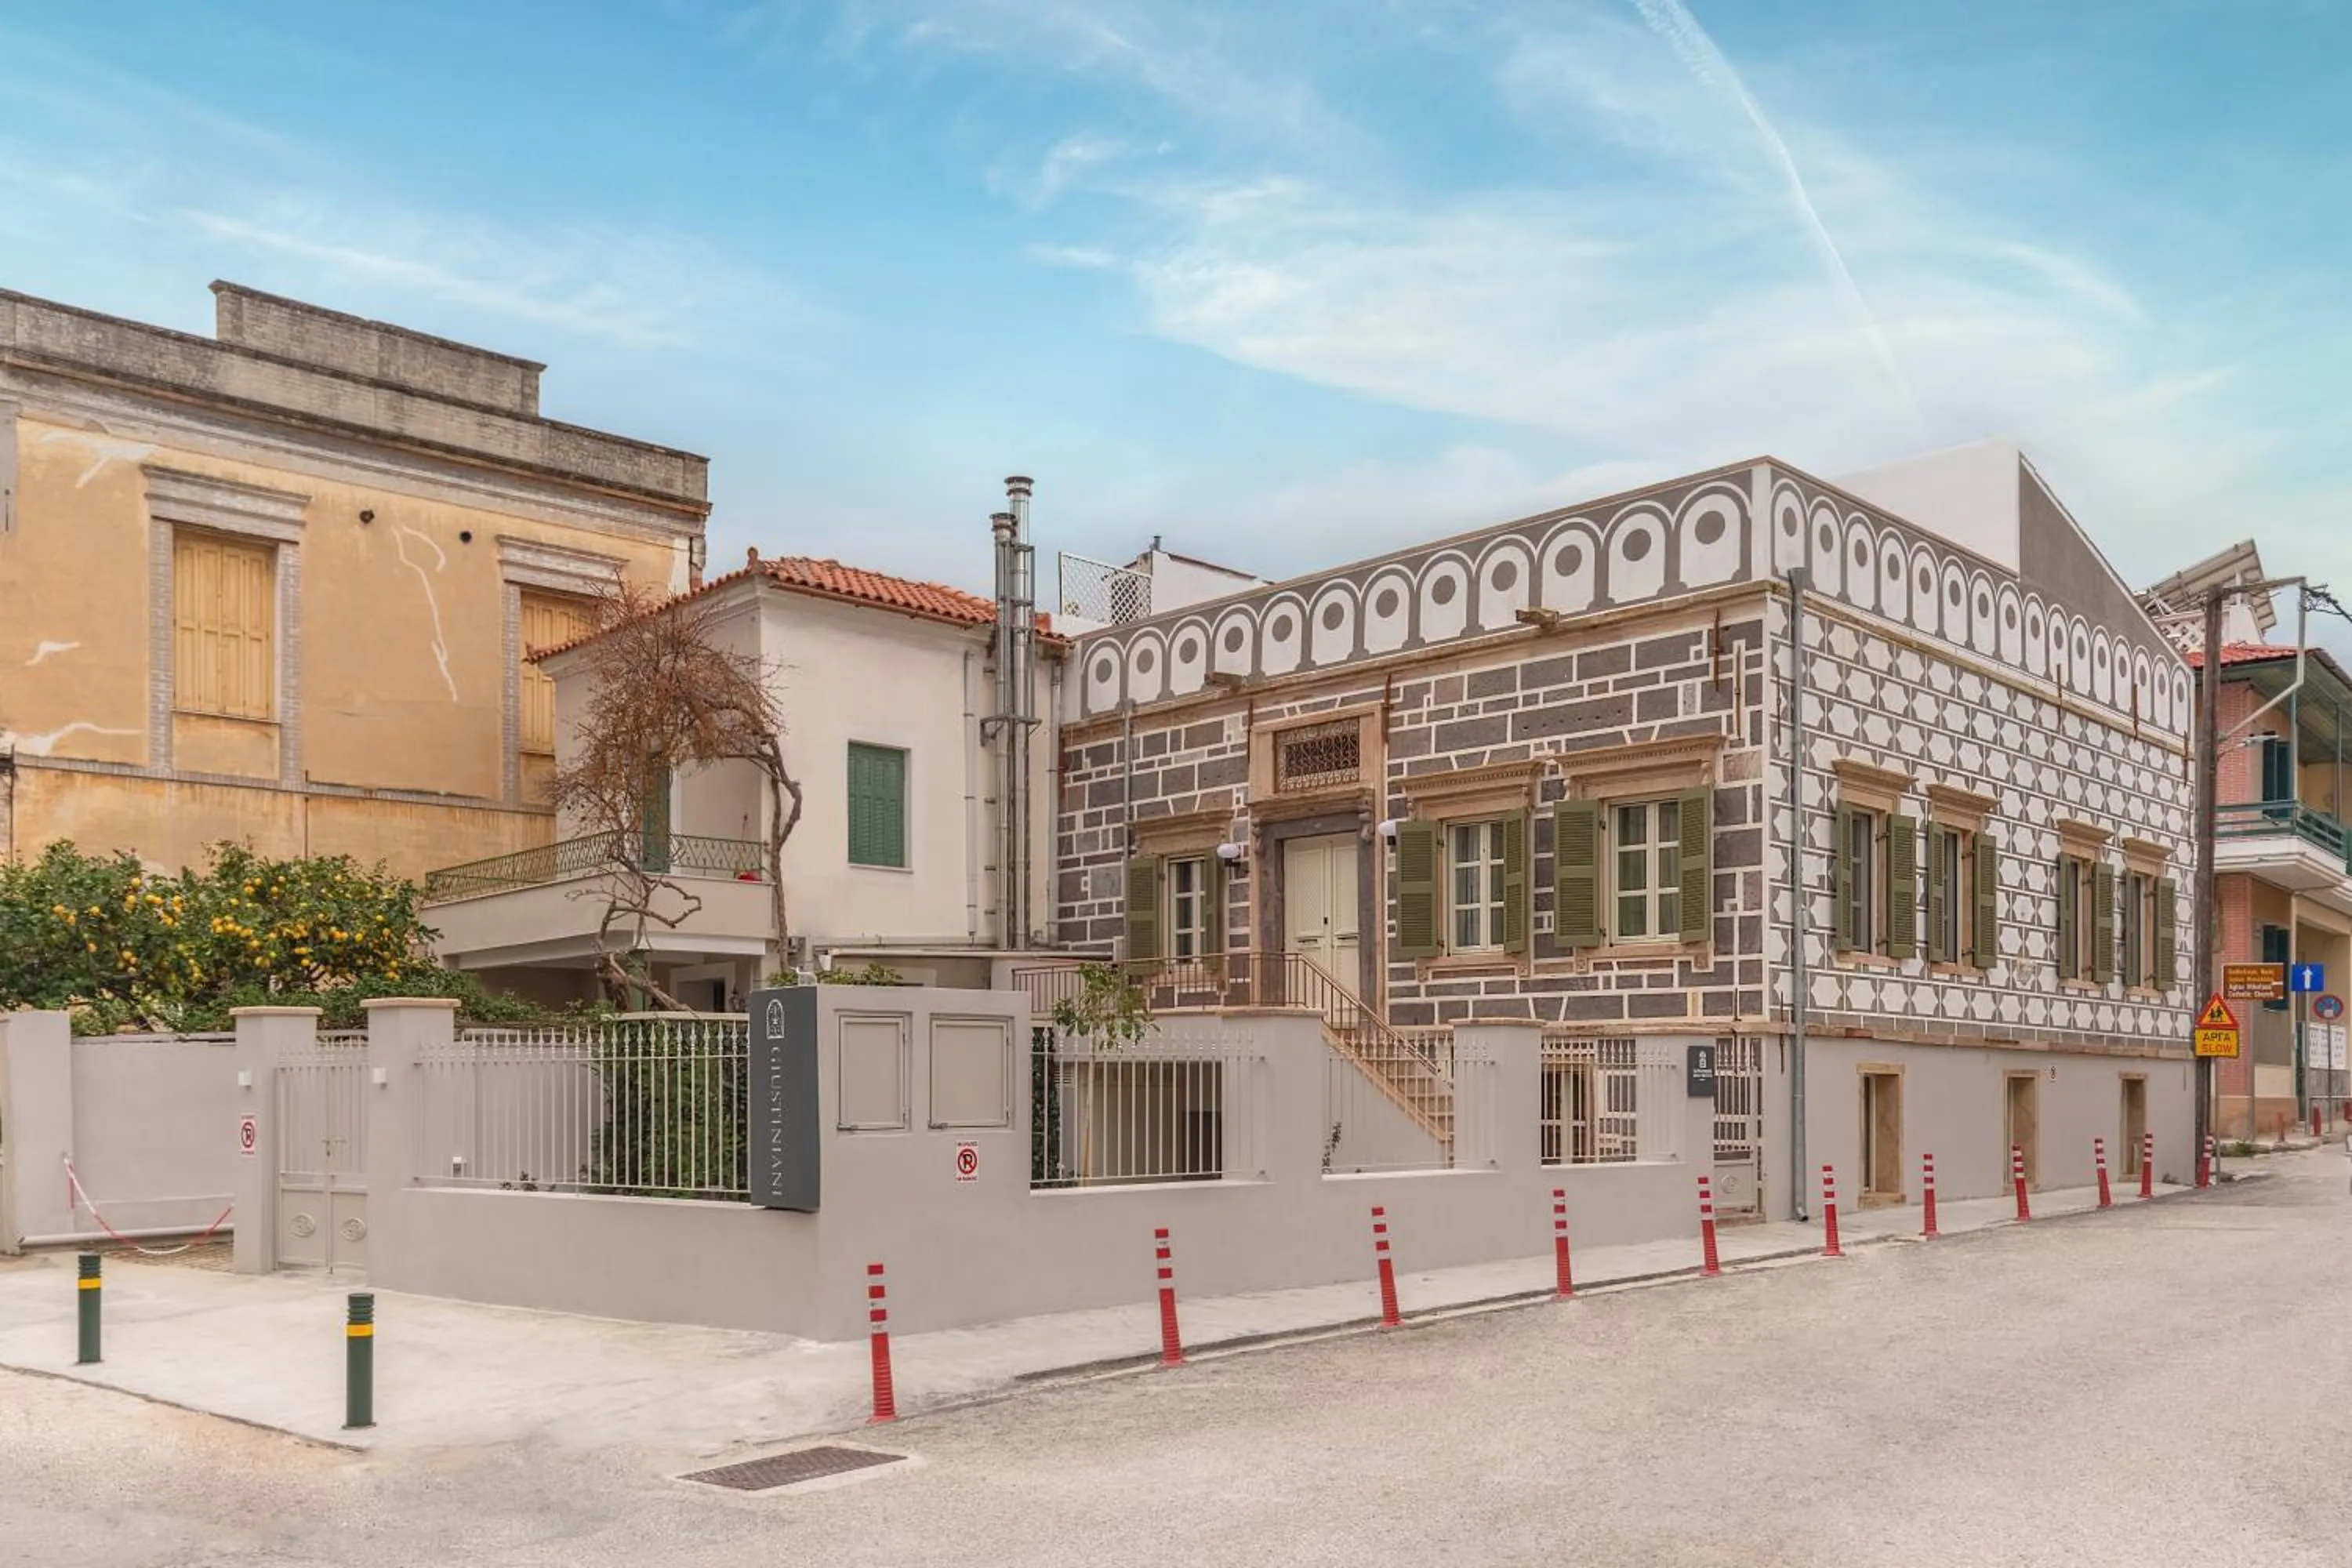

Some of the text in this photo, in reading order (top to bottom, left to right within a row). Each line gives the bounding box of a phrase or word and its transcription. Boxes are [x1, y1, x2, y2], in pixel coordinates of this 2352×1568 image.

[2202, 1032, 2231, 1042] ΑΡΓΑ
[2201, 1044, 2232, 1054] SLOW
[770, 1046, 783, 1197] GIUSTINIANI
